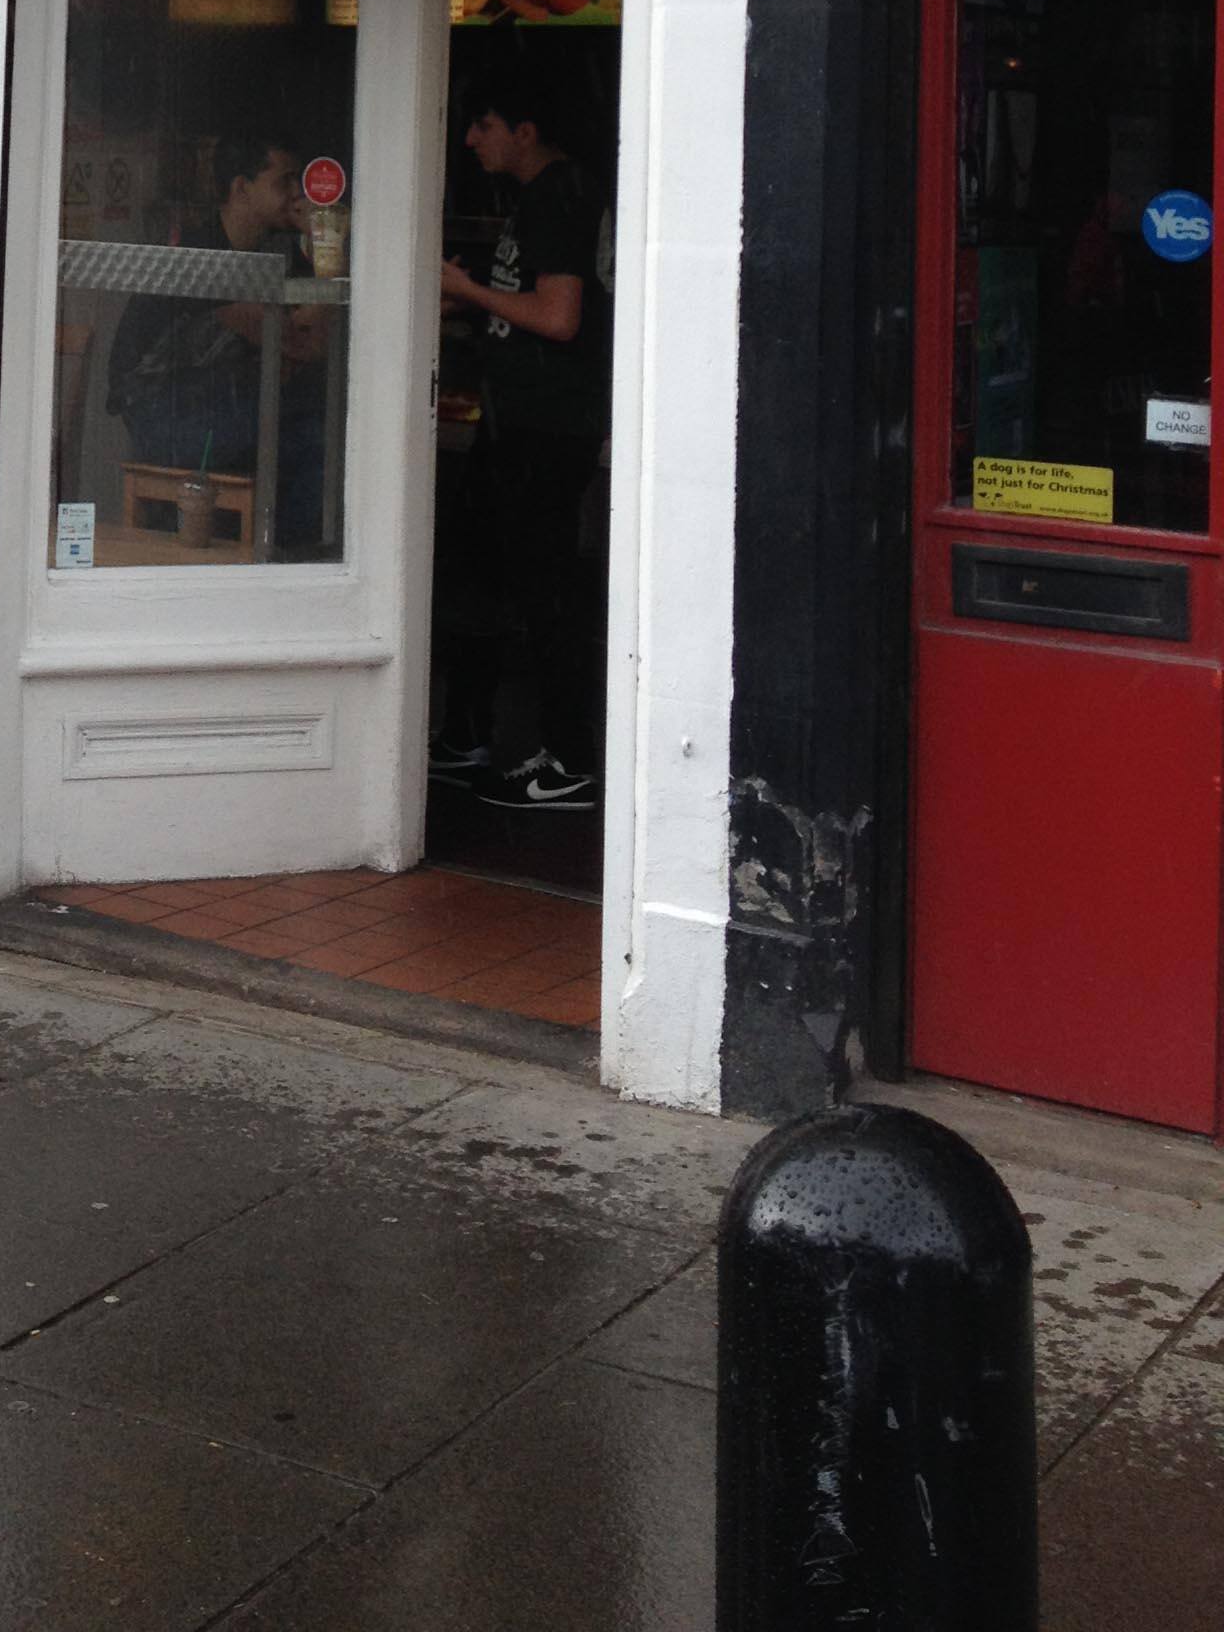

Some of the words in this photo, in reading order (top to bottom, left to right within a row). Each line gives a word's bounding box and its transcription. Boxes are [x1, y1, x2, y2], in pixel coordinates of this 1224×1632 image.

[1146, 207, 1210, 241] Yes
[1172, 410, 1191, 422] NO
[1156, 421, 1208, 435] CHANGE
[977, 461, 986, 471] A
[990, 462, 1013, 474] dog
[1016, 463, 1026, 474] is
[1030, 465, 1048, 476] for
[1051, 468, 1074, 480] life,
[977, 476, 997, 486] not
[1000, 478, 1023, 489] just
[1027, 480, 1045, 490] for
[1048, 481, 1109, 497] Christmas
